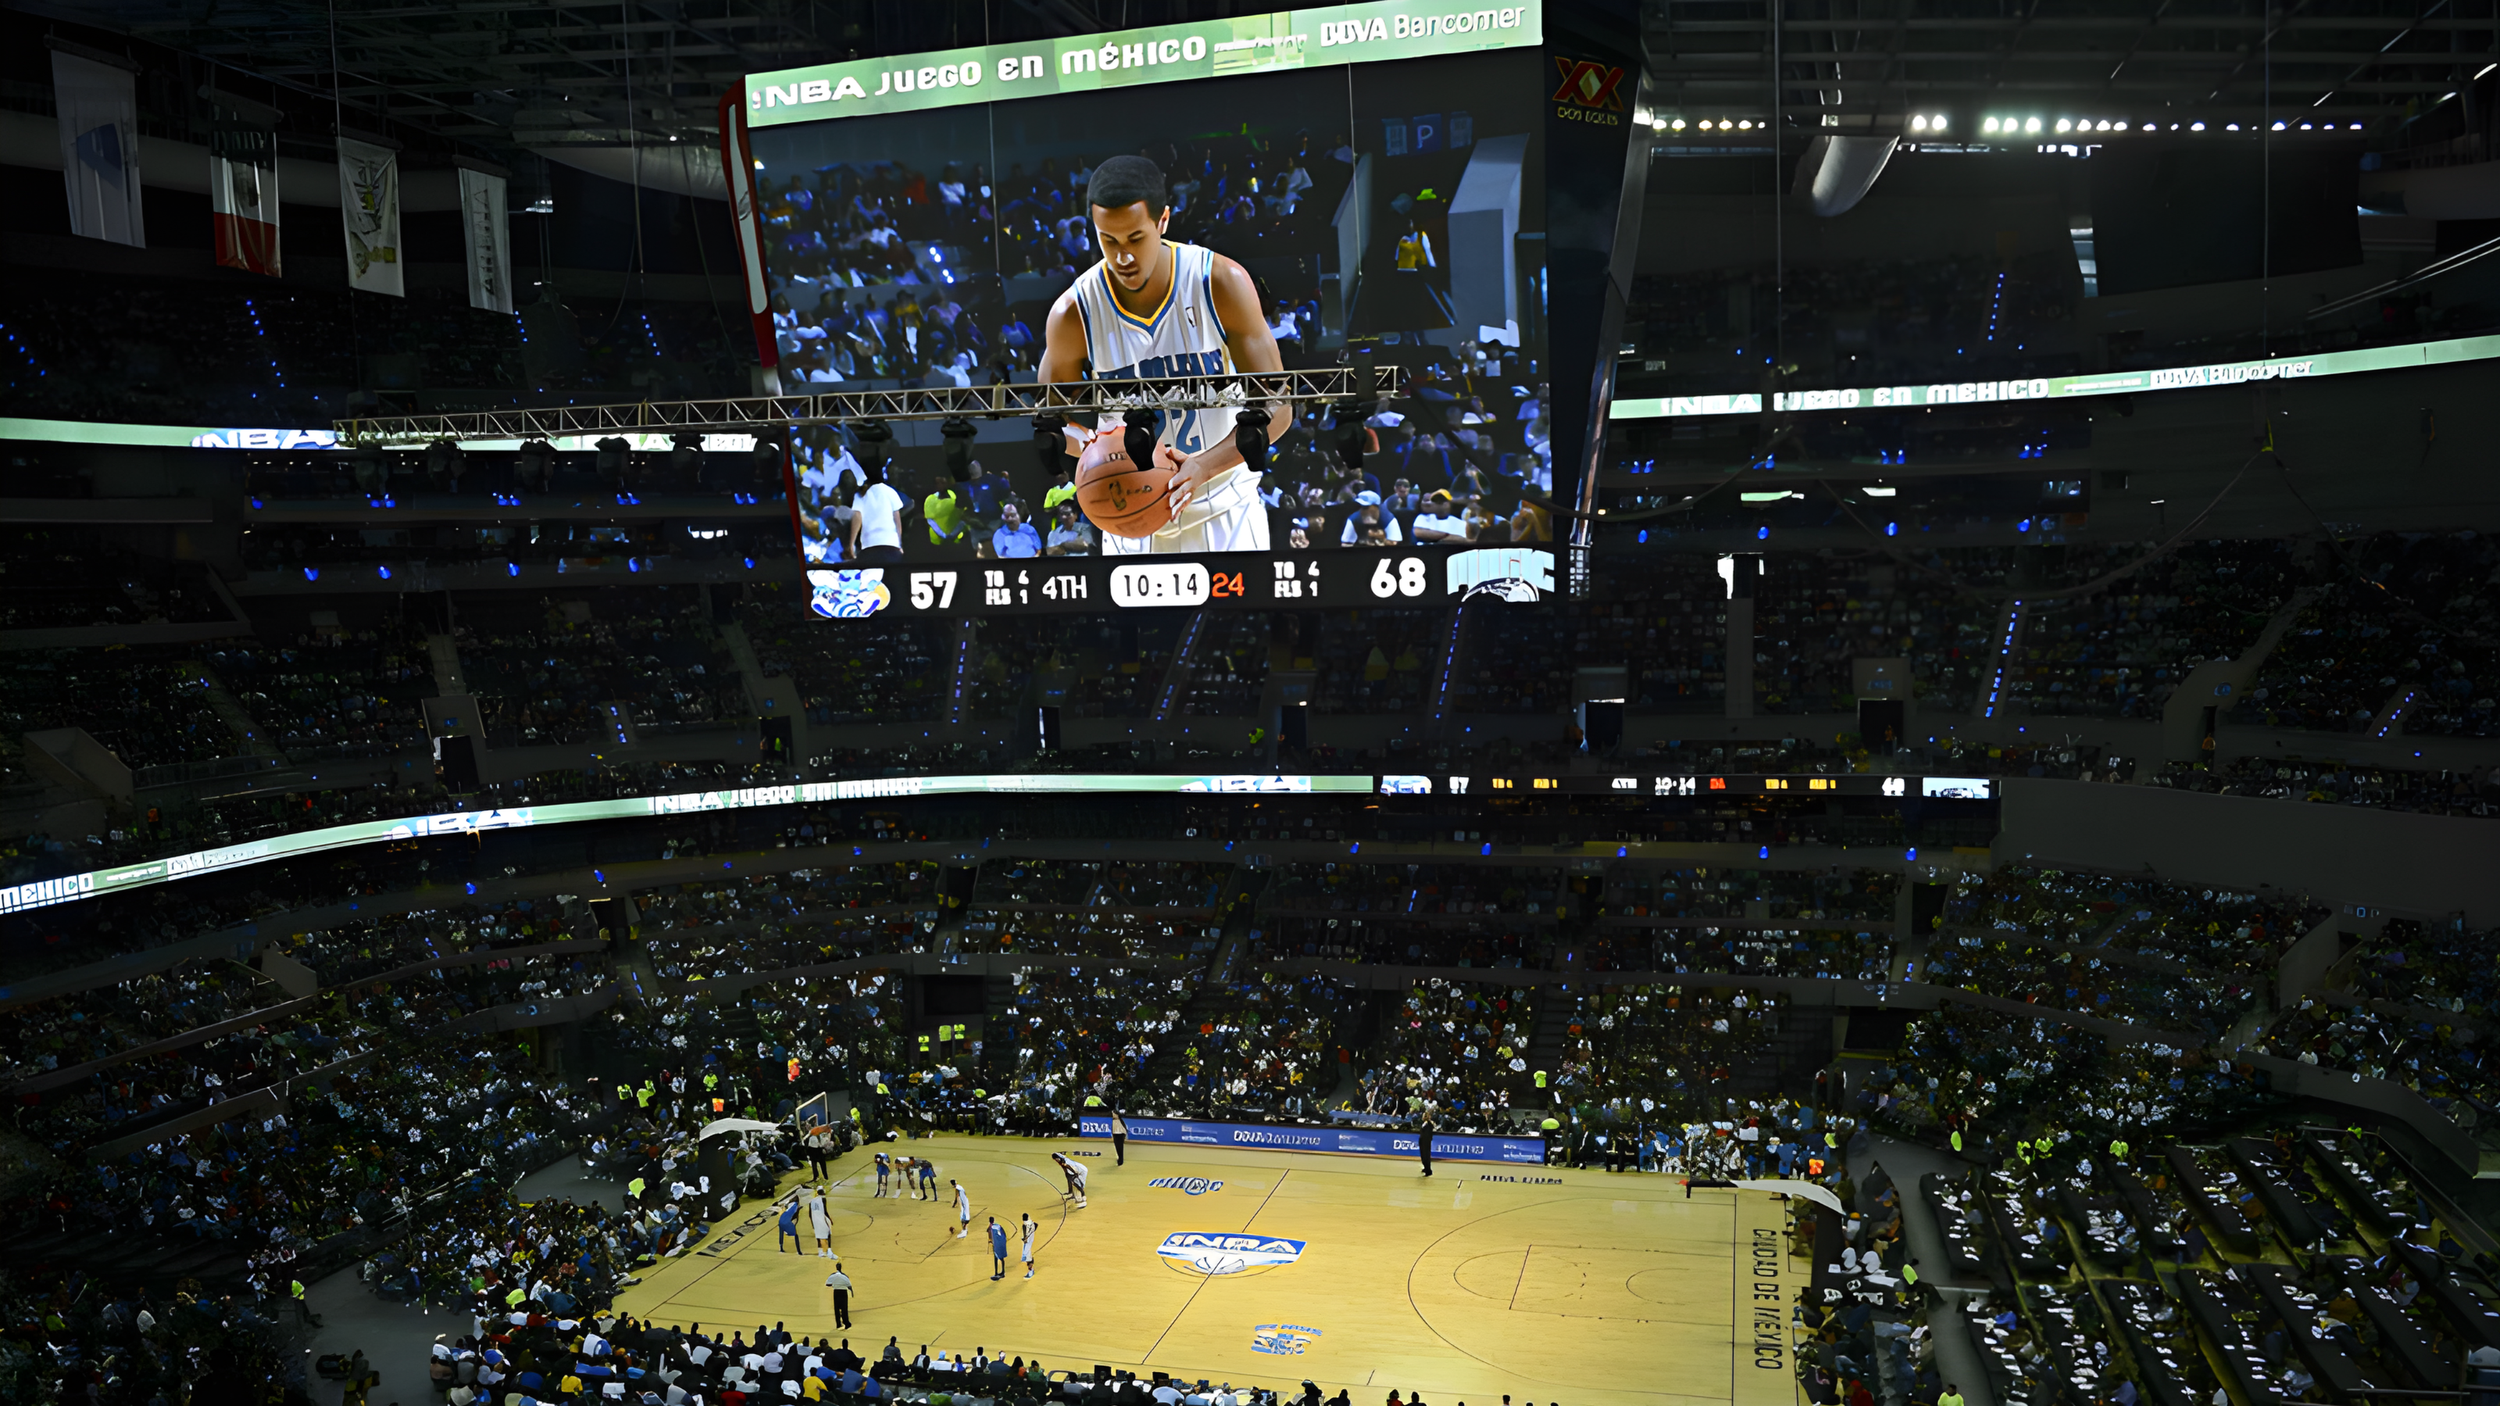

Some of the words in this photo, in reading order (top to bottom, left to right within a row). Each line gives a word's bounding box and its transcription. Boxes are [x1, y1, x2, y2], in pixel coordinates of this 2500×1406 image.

[766, 76, 866, 108] NBA
[875, 61, 982, 96] JUEGO
[1321, 17, 1388, 47] BBVA
[1394, 7, 1526, 39] Bancomer
[202, 430, 337, 450] NBA
[910, 571, 957, 609] 57
[1042, 575, 1088, 600] 4TH
[1124, 573, 1198, 597] 10:14
[1212, 572, 1245, 597] 24
[1370, 557, 1427, 598] 68
[1754, 1283, 1780, 1301] DE
